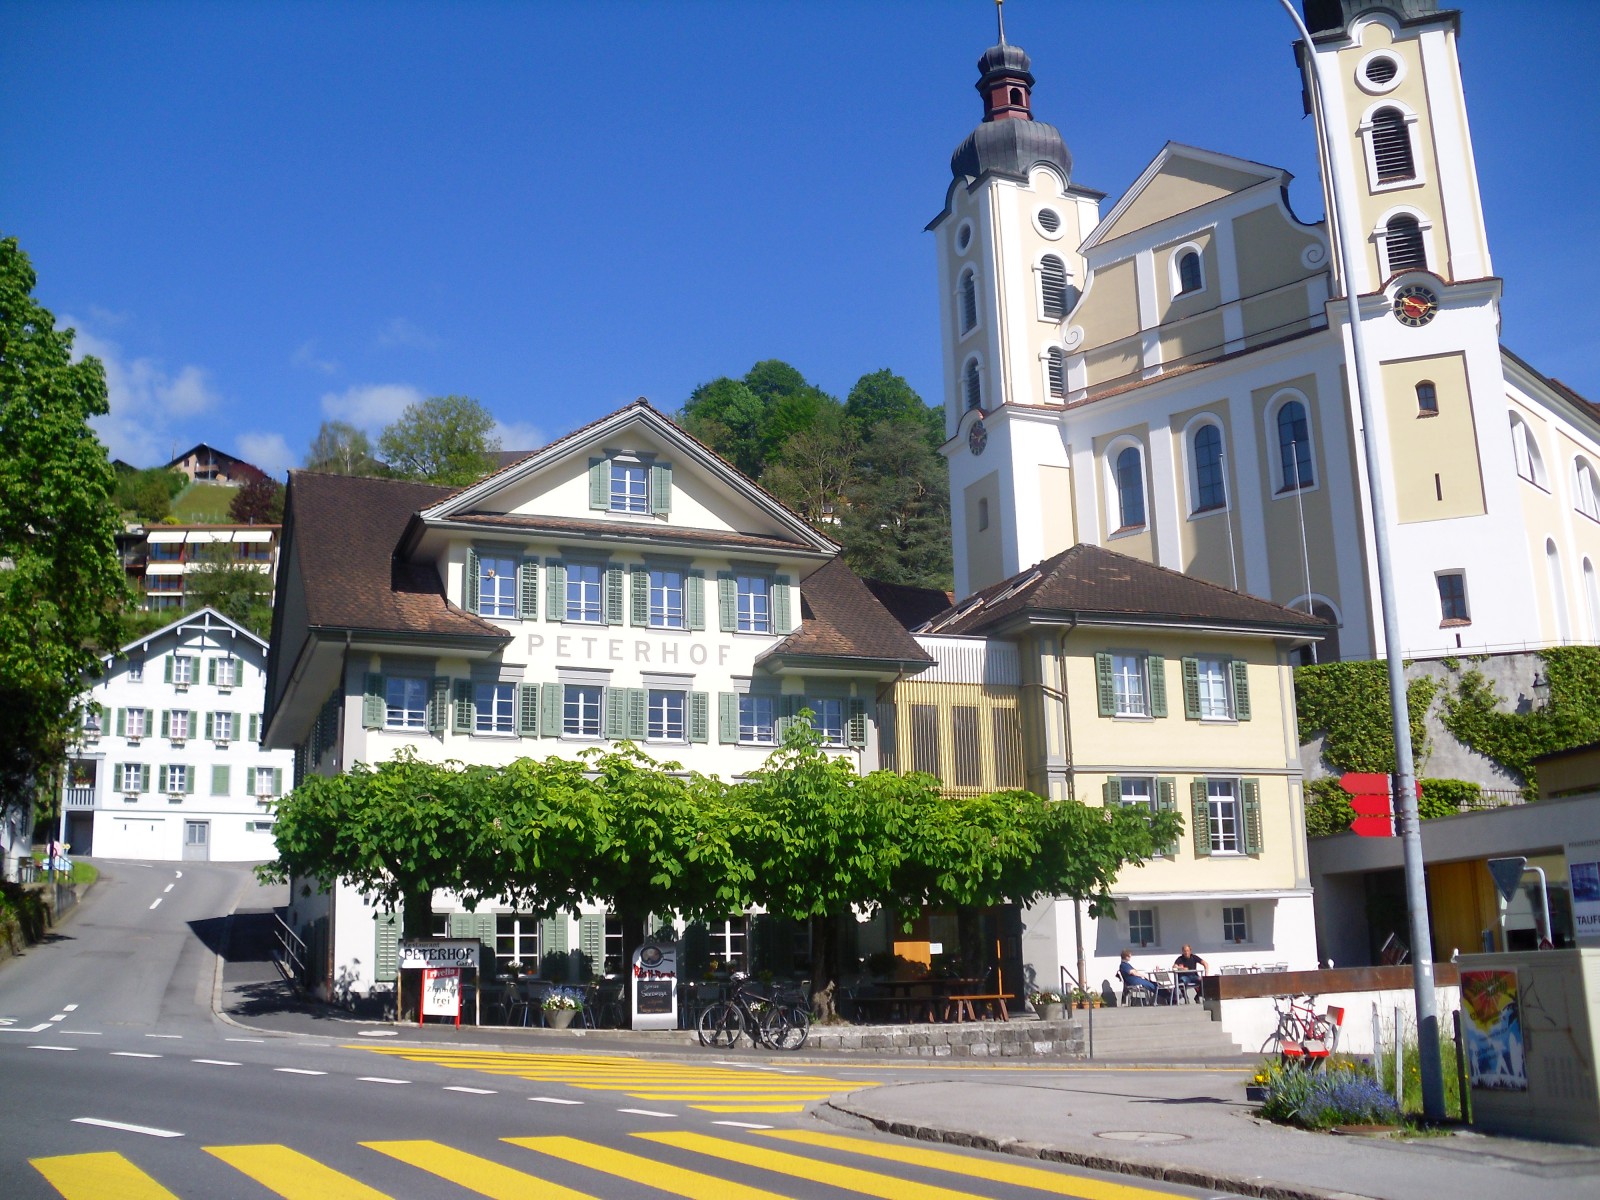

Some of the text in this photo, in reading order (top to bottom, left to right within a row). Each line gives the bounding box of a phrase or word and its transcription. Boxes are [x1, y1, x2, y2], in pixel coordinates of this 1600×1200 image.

[527, 633, 731, 667] PETERHOF
[404, 947, 474, 960] PETERHOF
[429, 968, 455, 978] rivella
[432, 995, 450, 1005] frei
